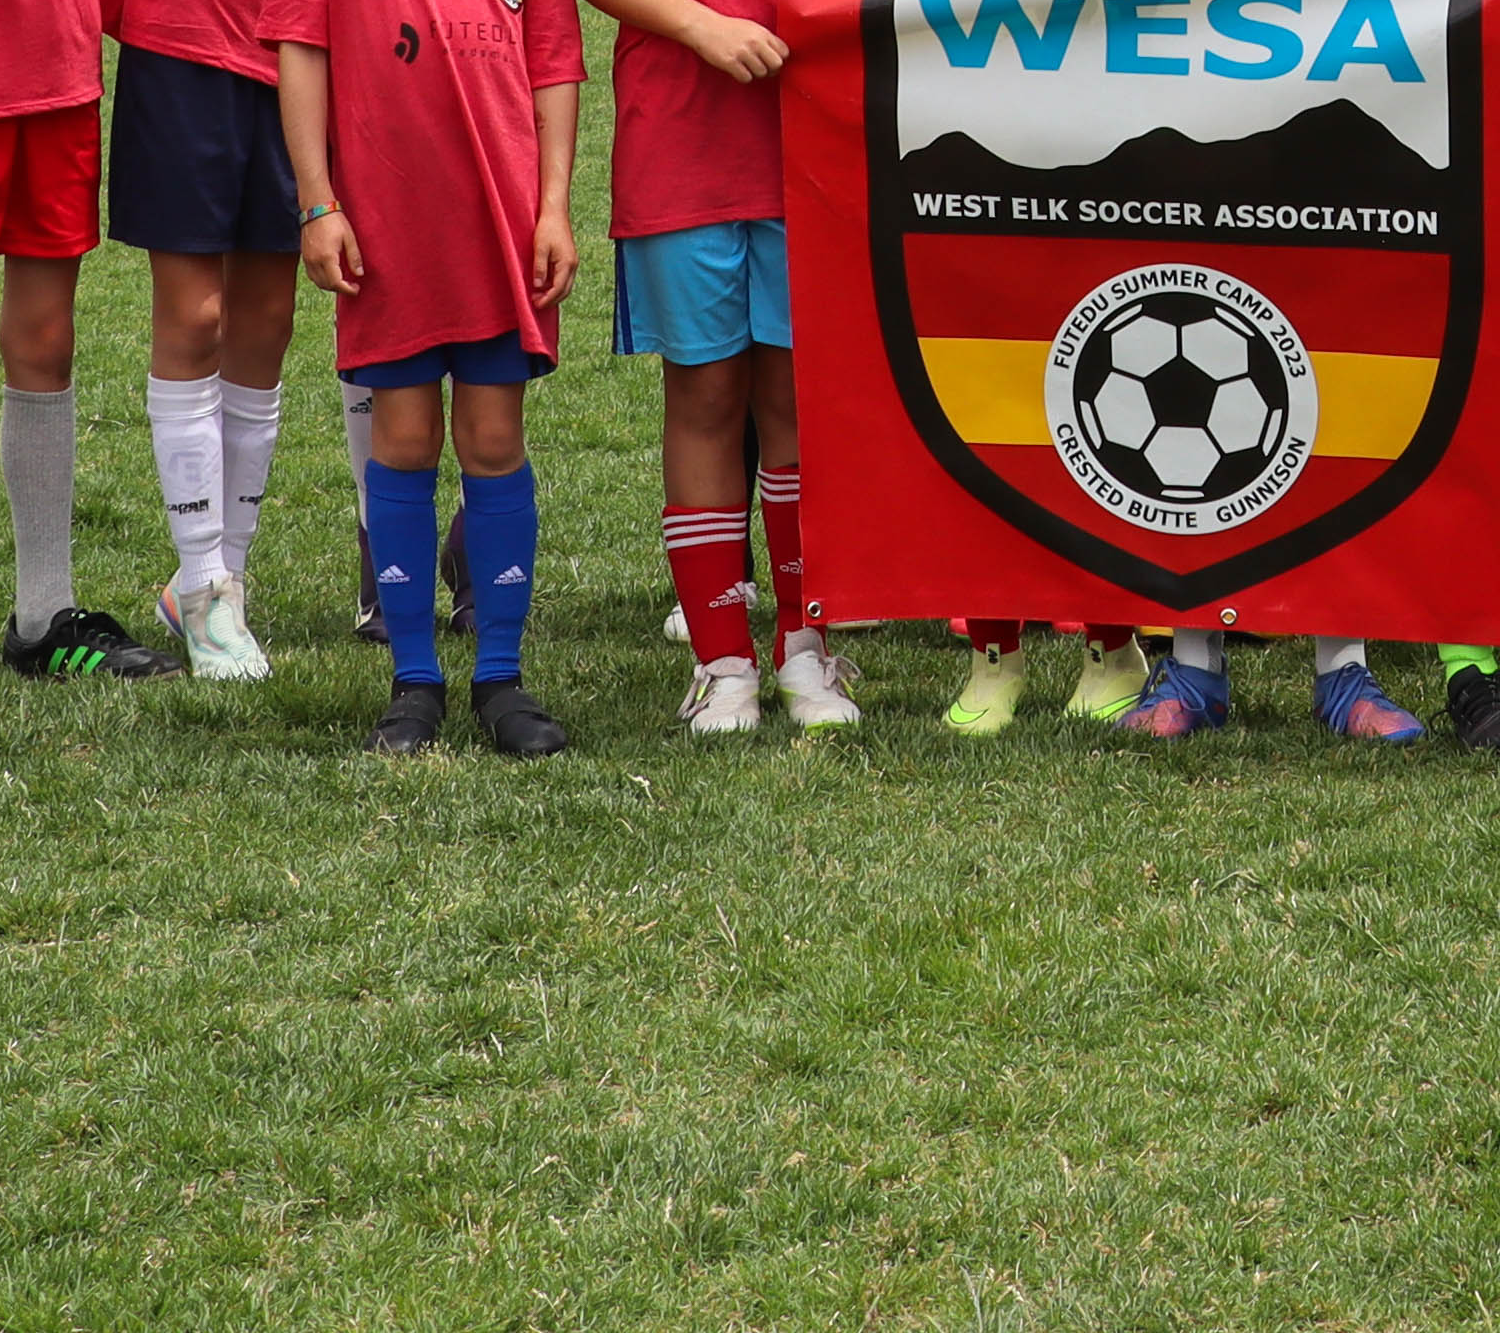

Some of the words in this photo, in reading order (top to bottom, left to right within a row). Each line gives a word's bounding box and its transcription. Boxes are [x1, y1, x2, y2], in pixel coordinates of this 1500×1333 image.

[913, 192, 1000, 218] WEST
[1011, 197, 1069, 221] ELK
[1078, 200, 1204, 226] SOCCER
[1214, 204, 1438, 235] ASSOCIATION
[1054, 292, 1110, 369] FUTEDU
[1111, 269, 1209, 301] SUMMER
[1215, 278, 1274, 322] CAMP
[1270, 324, 1307, 379] 2023
[1056, 422, 1125, 507] CRESTED
[1127, 499, 1198, 529] BUTTE
[1216, 436, 1307, 524] GUNNISON
